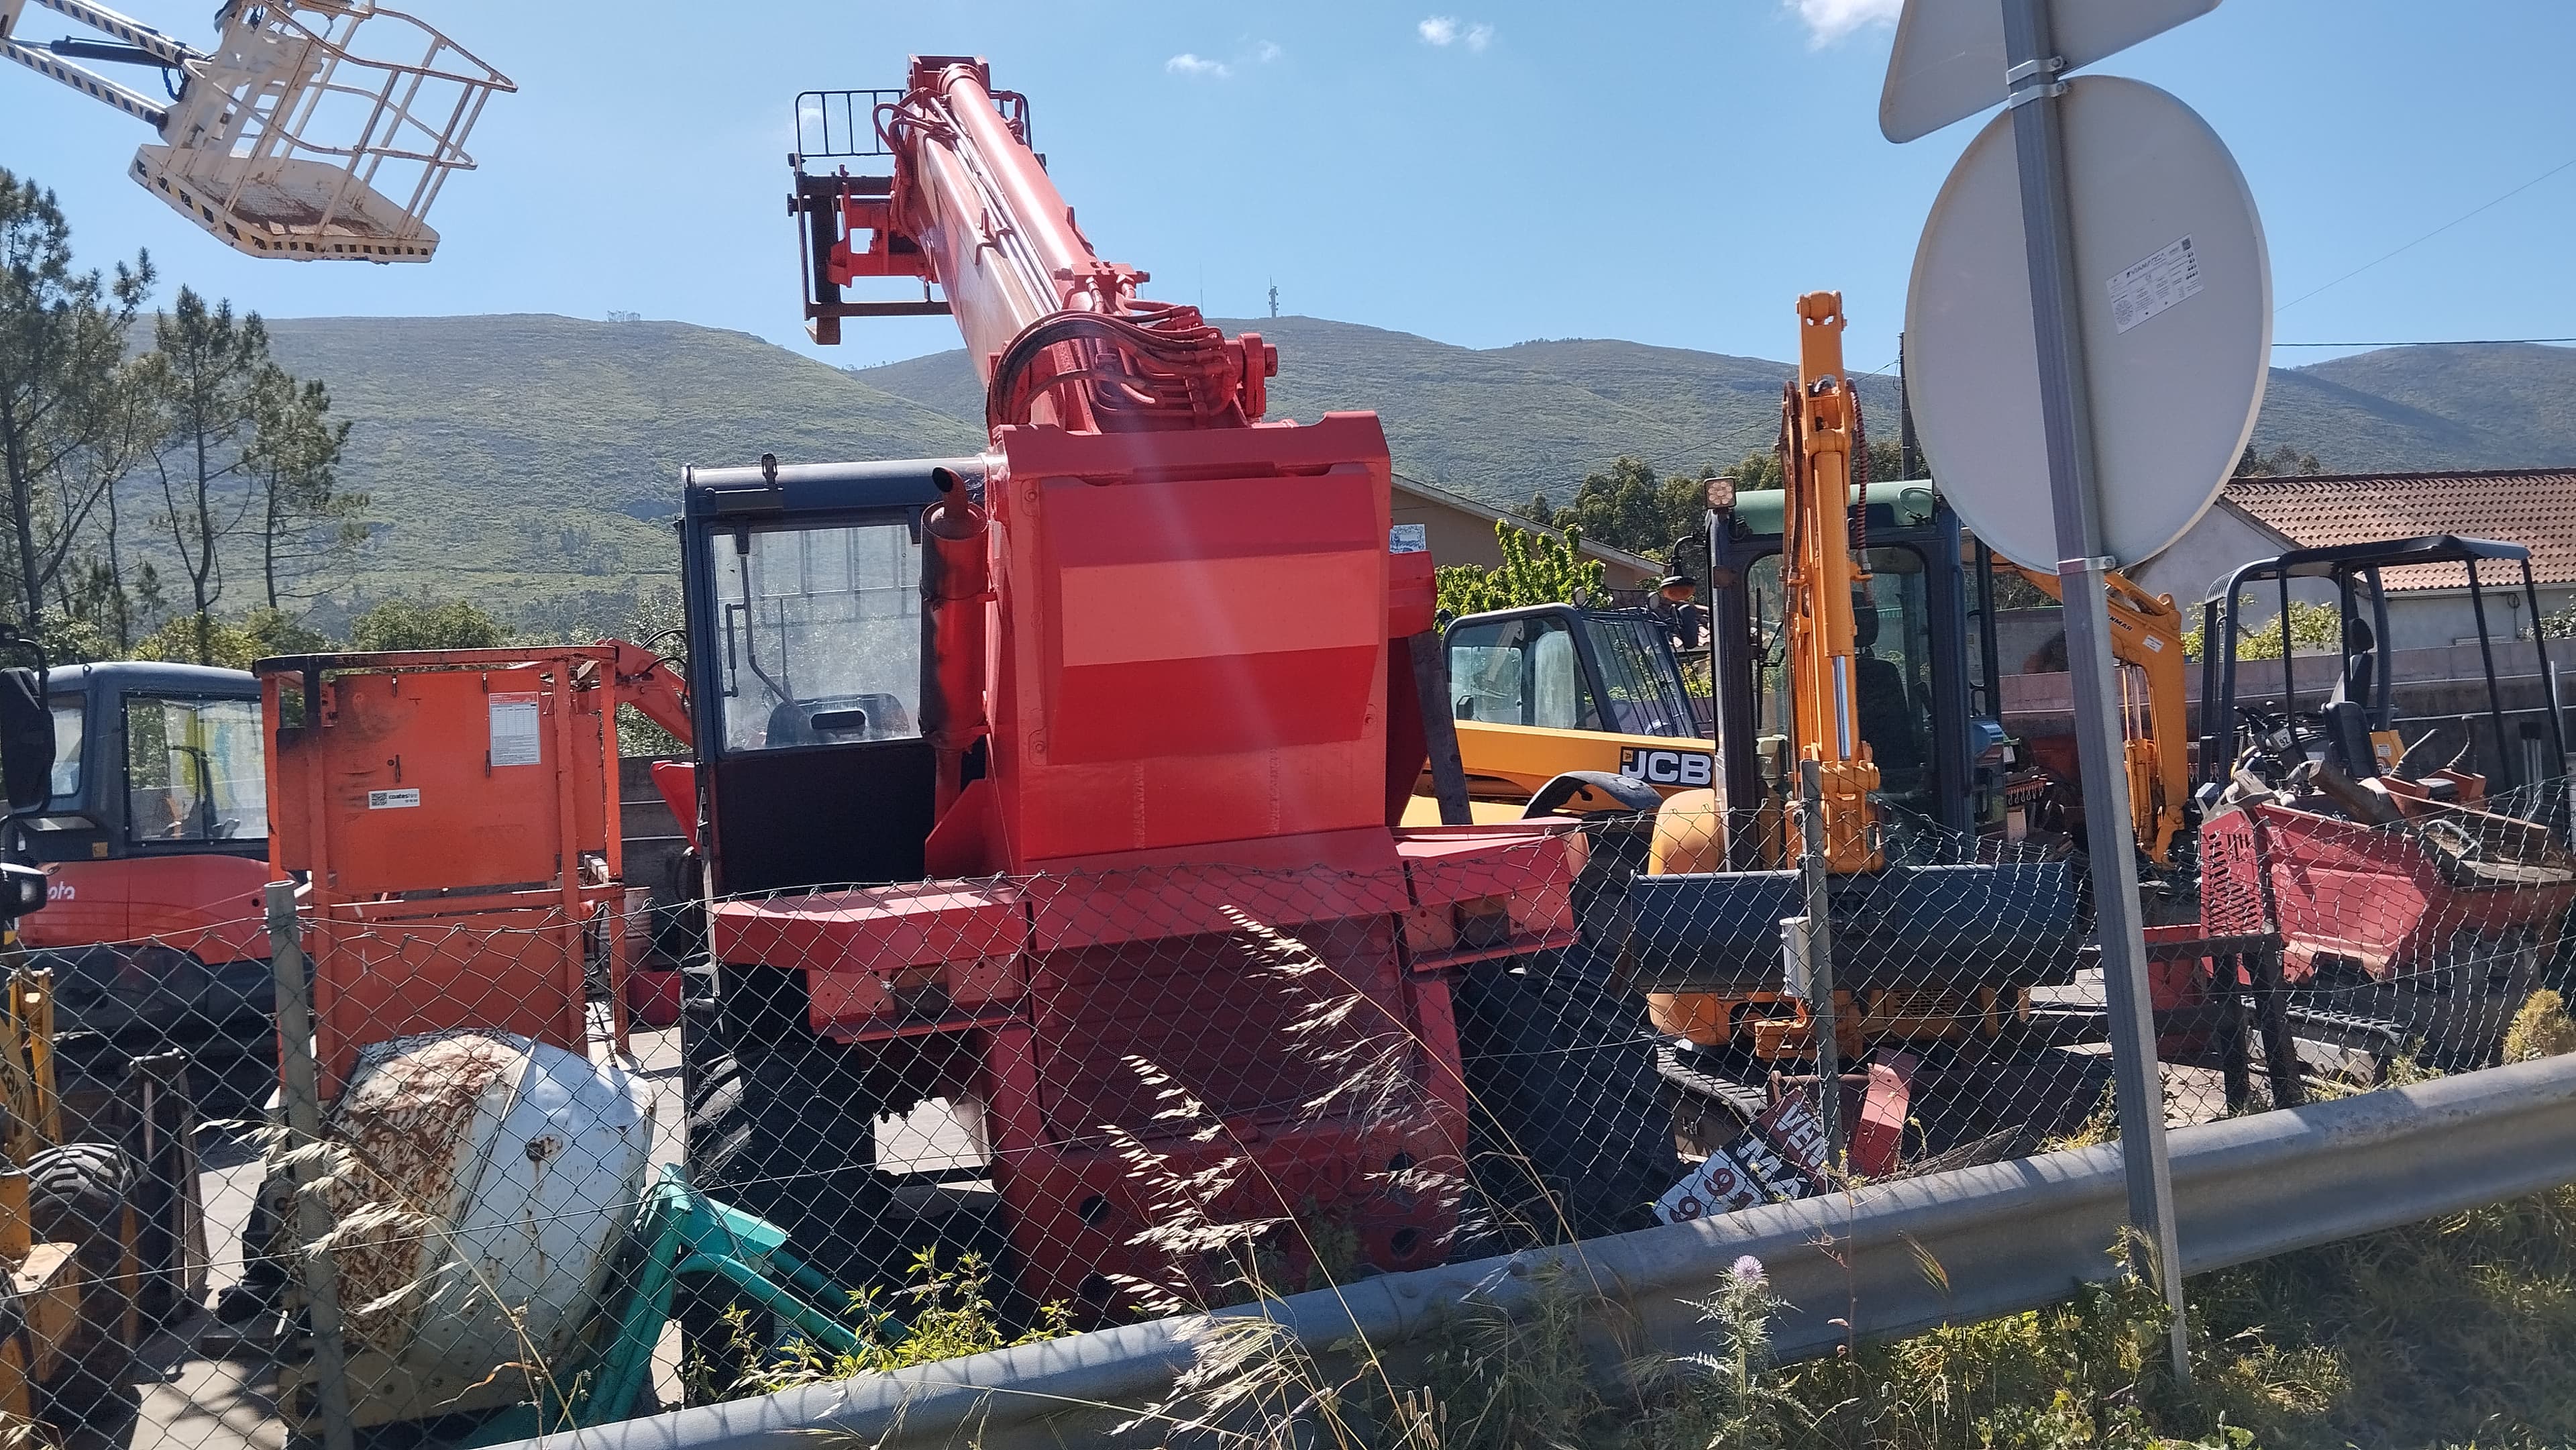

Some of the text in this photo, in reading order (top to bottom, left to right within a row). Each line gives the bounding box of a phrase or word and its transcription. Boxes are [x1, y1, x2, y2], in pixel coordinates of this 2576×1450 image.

[2108, 613, 2133, 631] NMAR
[1621, 751, 1711, 785] JCB
[48, 880, 75, 900] ota
